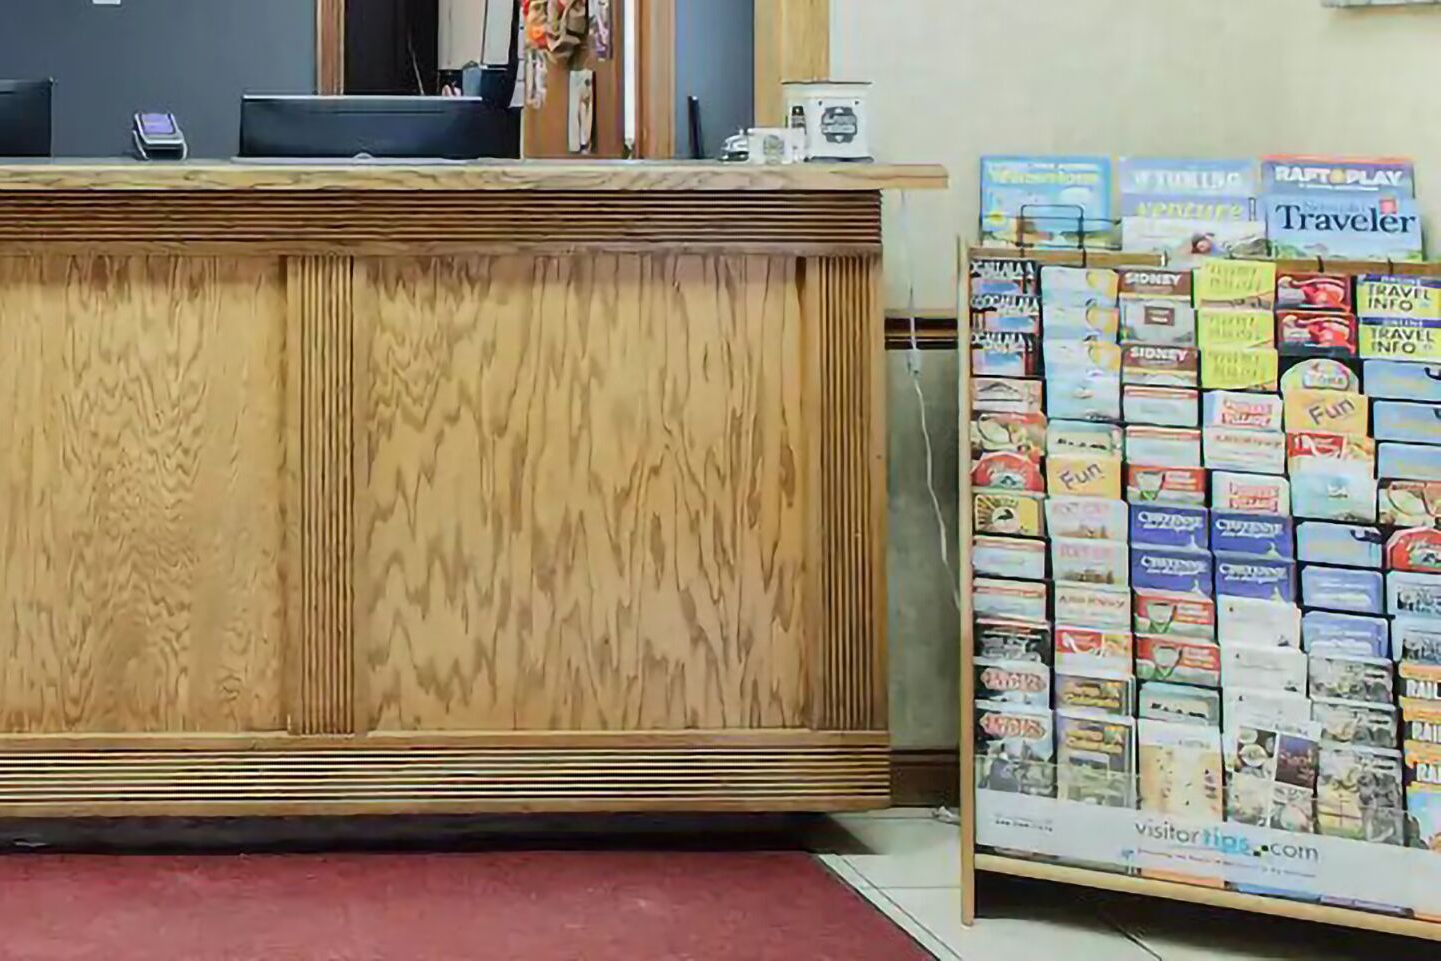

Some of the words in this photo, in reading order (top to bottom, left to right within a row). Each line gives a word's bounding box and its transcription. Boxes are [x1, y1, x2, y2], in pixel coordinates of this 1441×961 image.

[1275, 204, 1416, 233] Traveler
[1124, 272, 1183, 286] SIDNEY
[1368, 284, 1432, 301] TRAVEL
[1368, 296, 1414, 312] INFO
[1371, 327, 1435, 343] TRAVEL
[1130, 346, 1189, 362] SIDNEY
[1371, 341, 1416, 355] INFO
[1309, 399, 1355, 425] Fun
[1059, 463, 1103, 490] Fun
